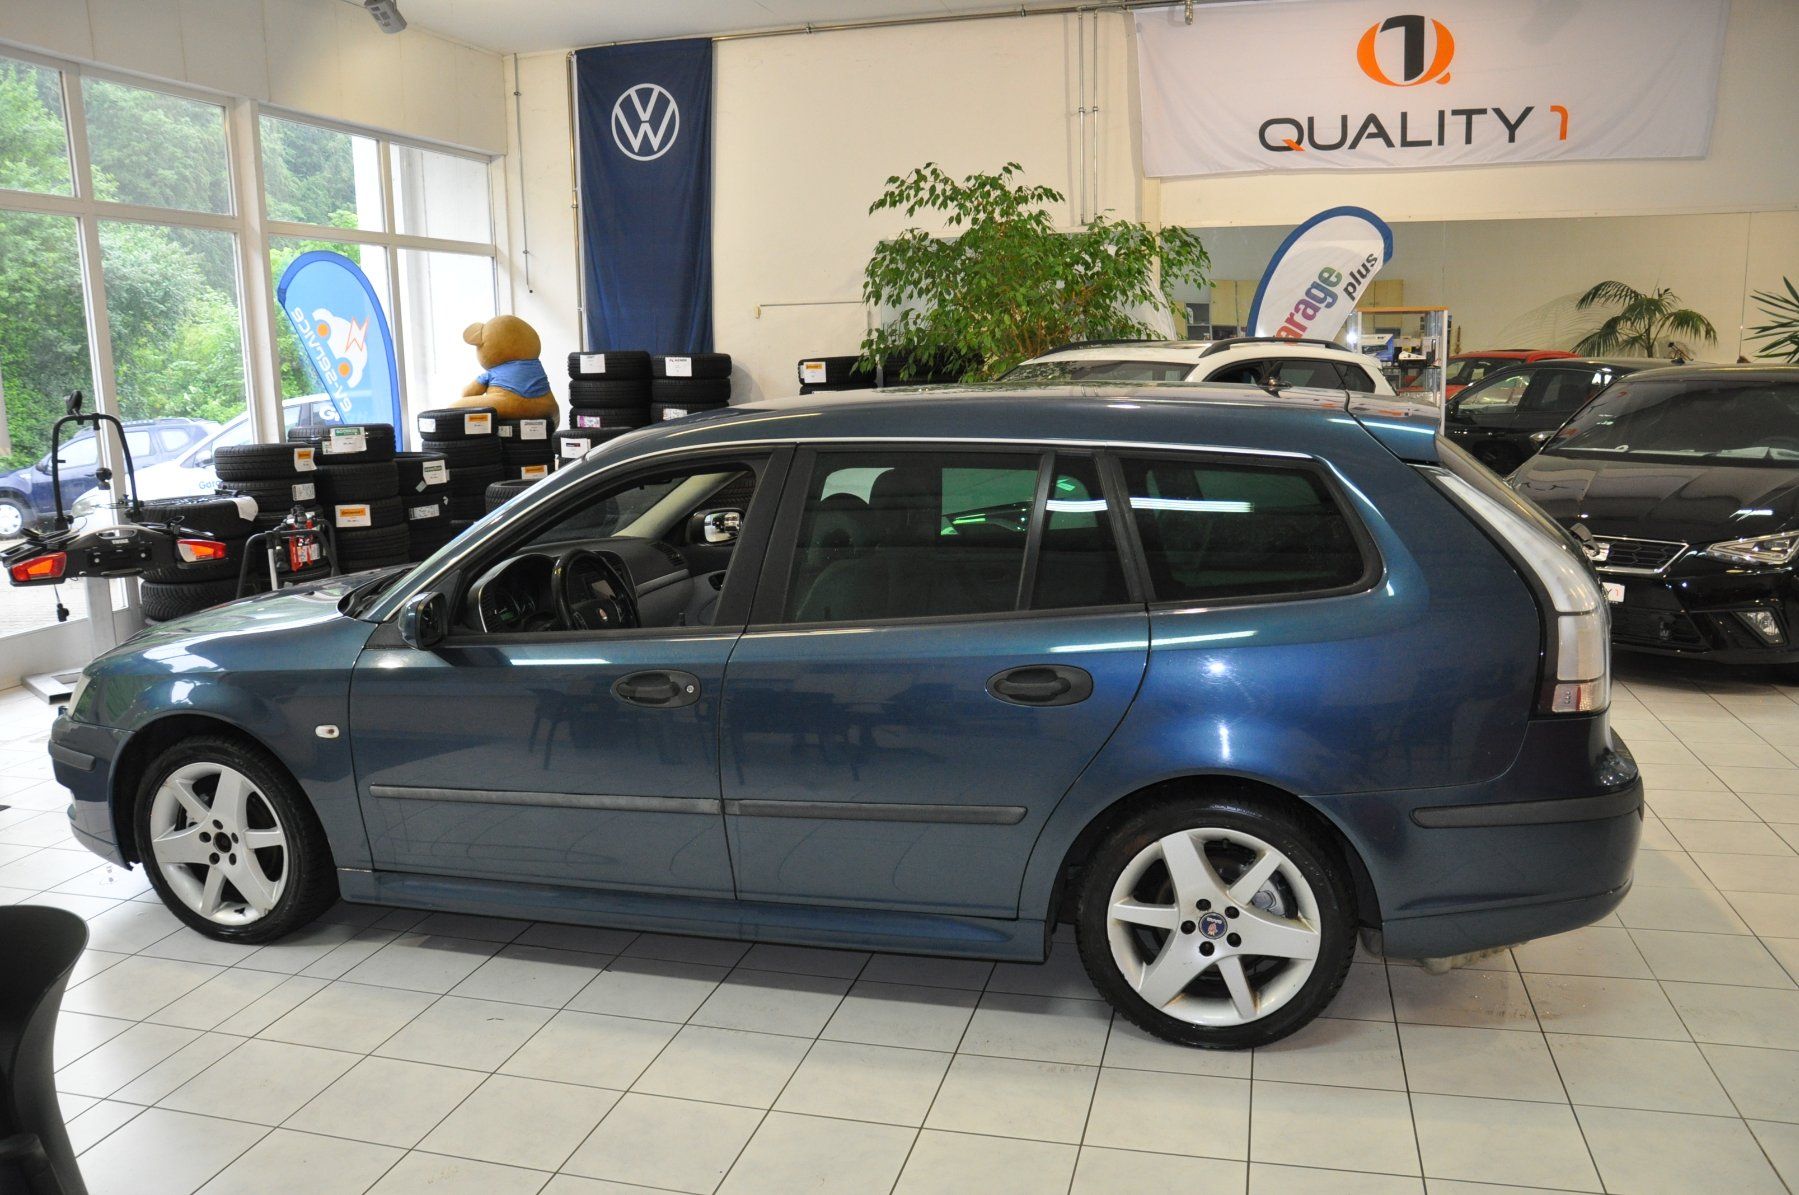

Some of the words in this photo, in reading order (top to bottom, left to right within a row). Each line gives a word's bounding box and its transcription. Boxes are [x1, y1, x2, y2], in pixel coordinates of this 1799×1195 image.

[1258, 105, 1535, 152] QUALITY
[1549, 104, 1568, 141] 1
[1342, 253, 1378, 301] plus
